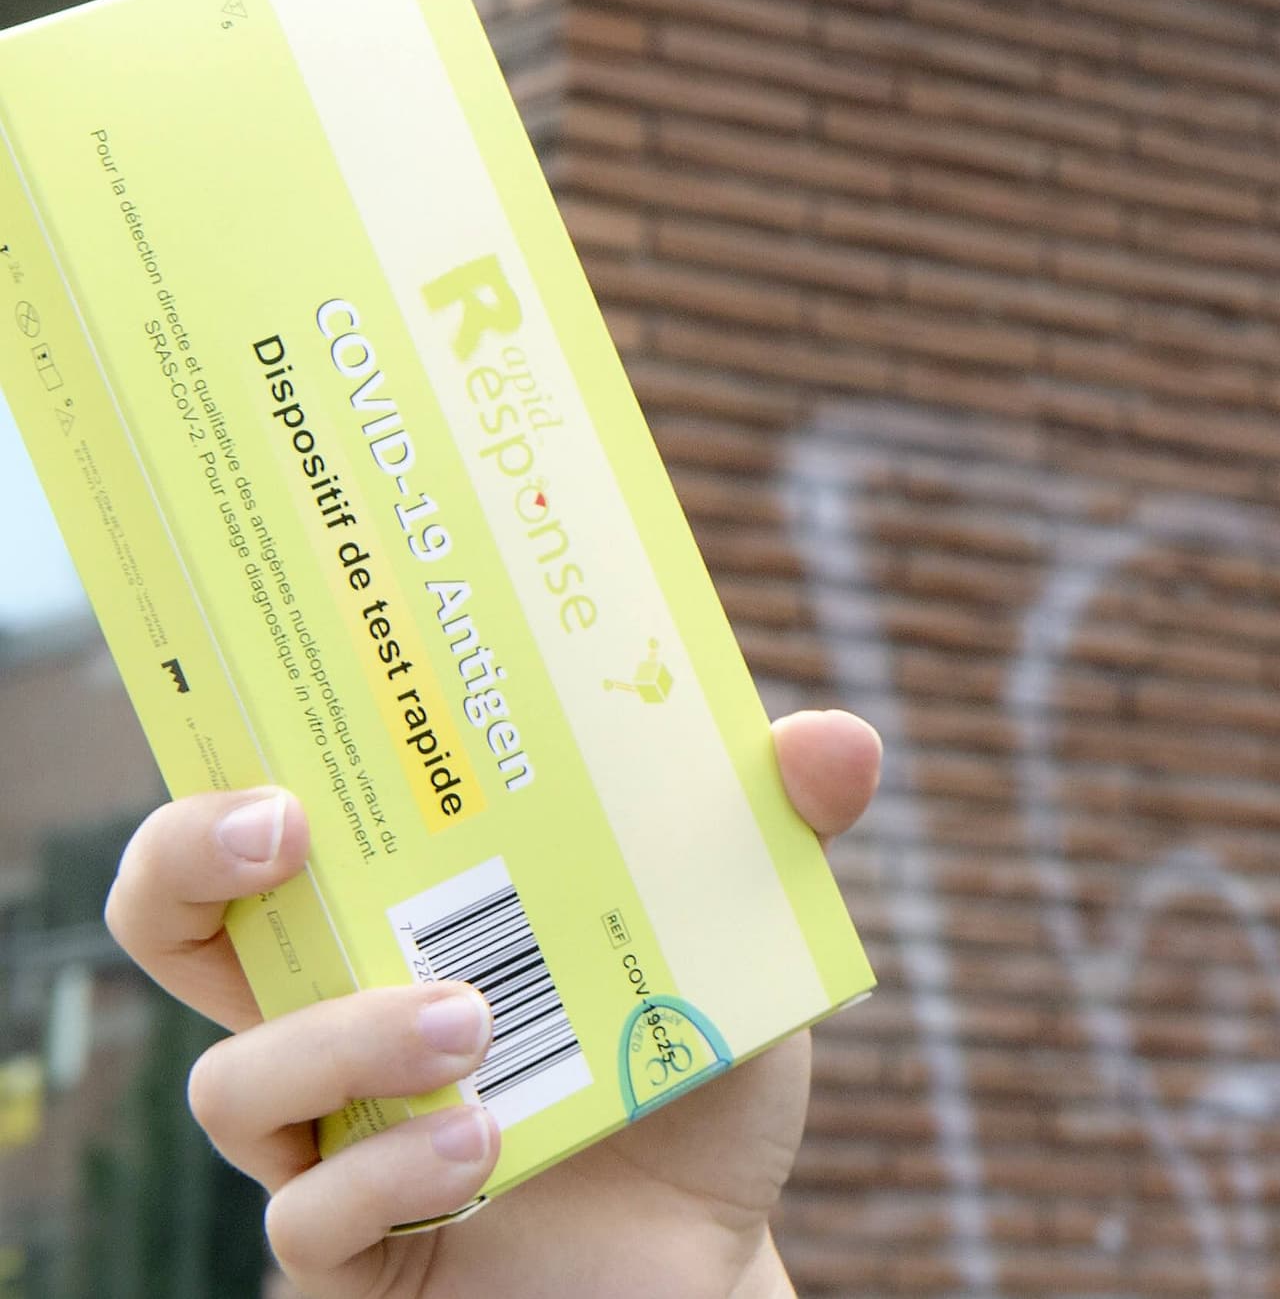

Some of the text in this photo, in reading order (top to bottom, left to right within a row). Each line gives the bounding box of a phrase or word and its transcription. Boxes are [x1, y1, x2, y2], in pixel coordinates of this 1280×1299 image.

[90, 129, 397, 854] Pour la détection directe et qualitative des antigènes nucléoprotéiques viraux du
[144, 319, 375, 863] SRAS-CoV-2. Pour usage diagnostique in vitro uniquement.
[253, 335, 461, 815] Dispositif de test rapide
[315, 296, 537, 792] COVID-19 Antigen
[400, 921, 413, 931] 7
[606, 914, 626, 942] REF
[622, 953, 677, 1064] COV-19C25
